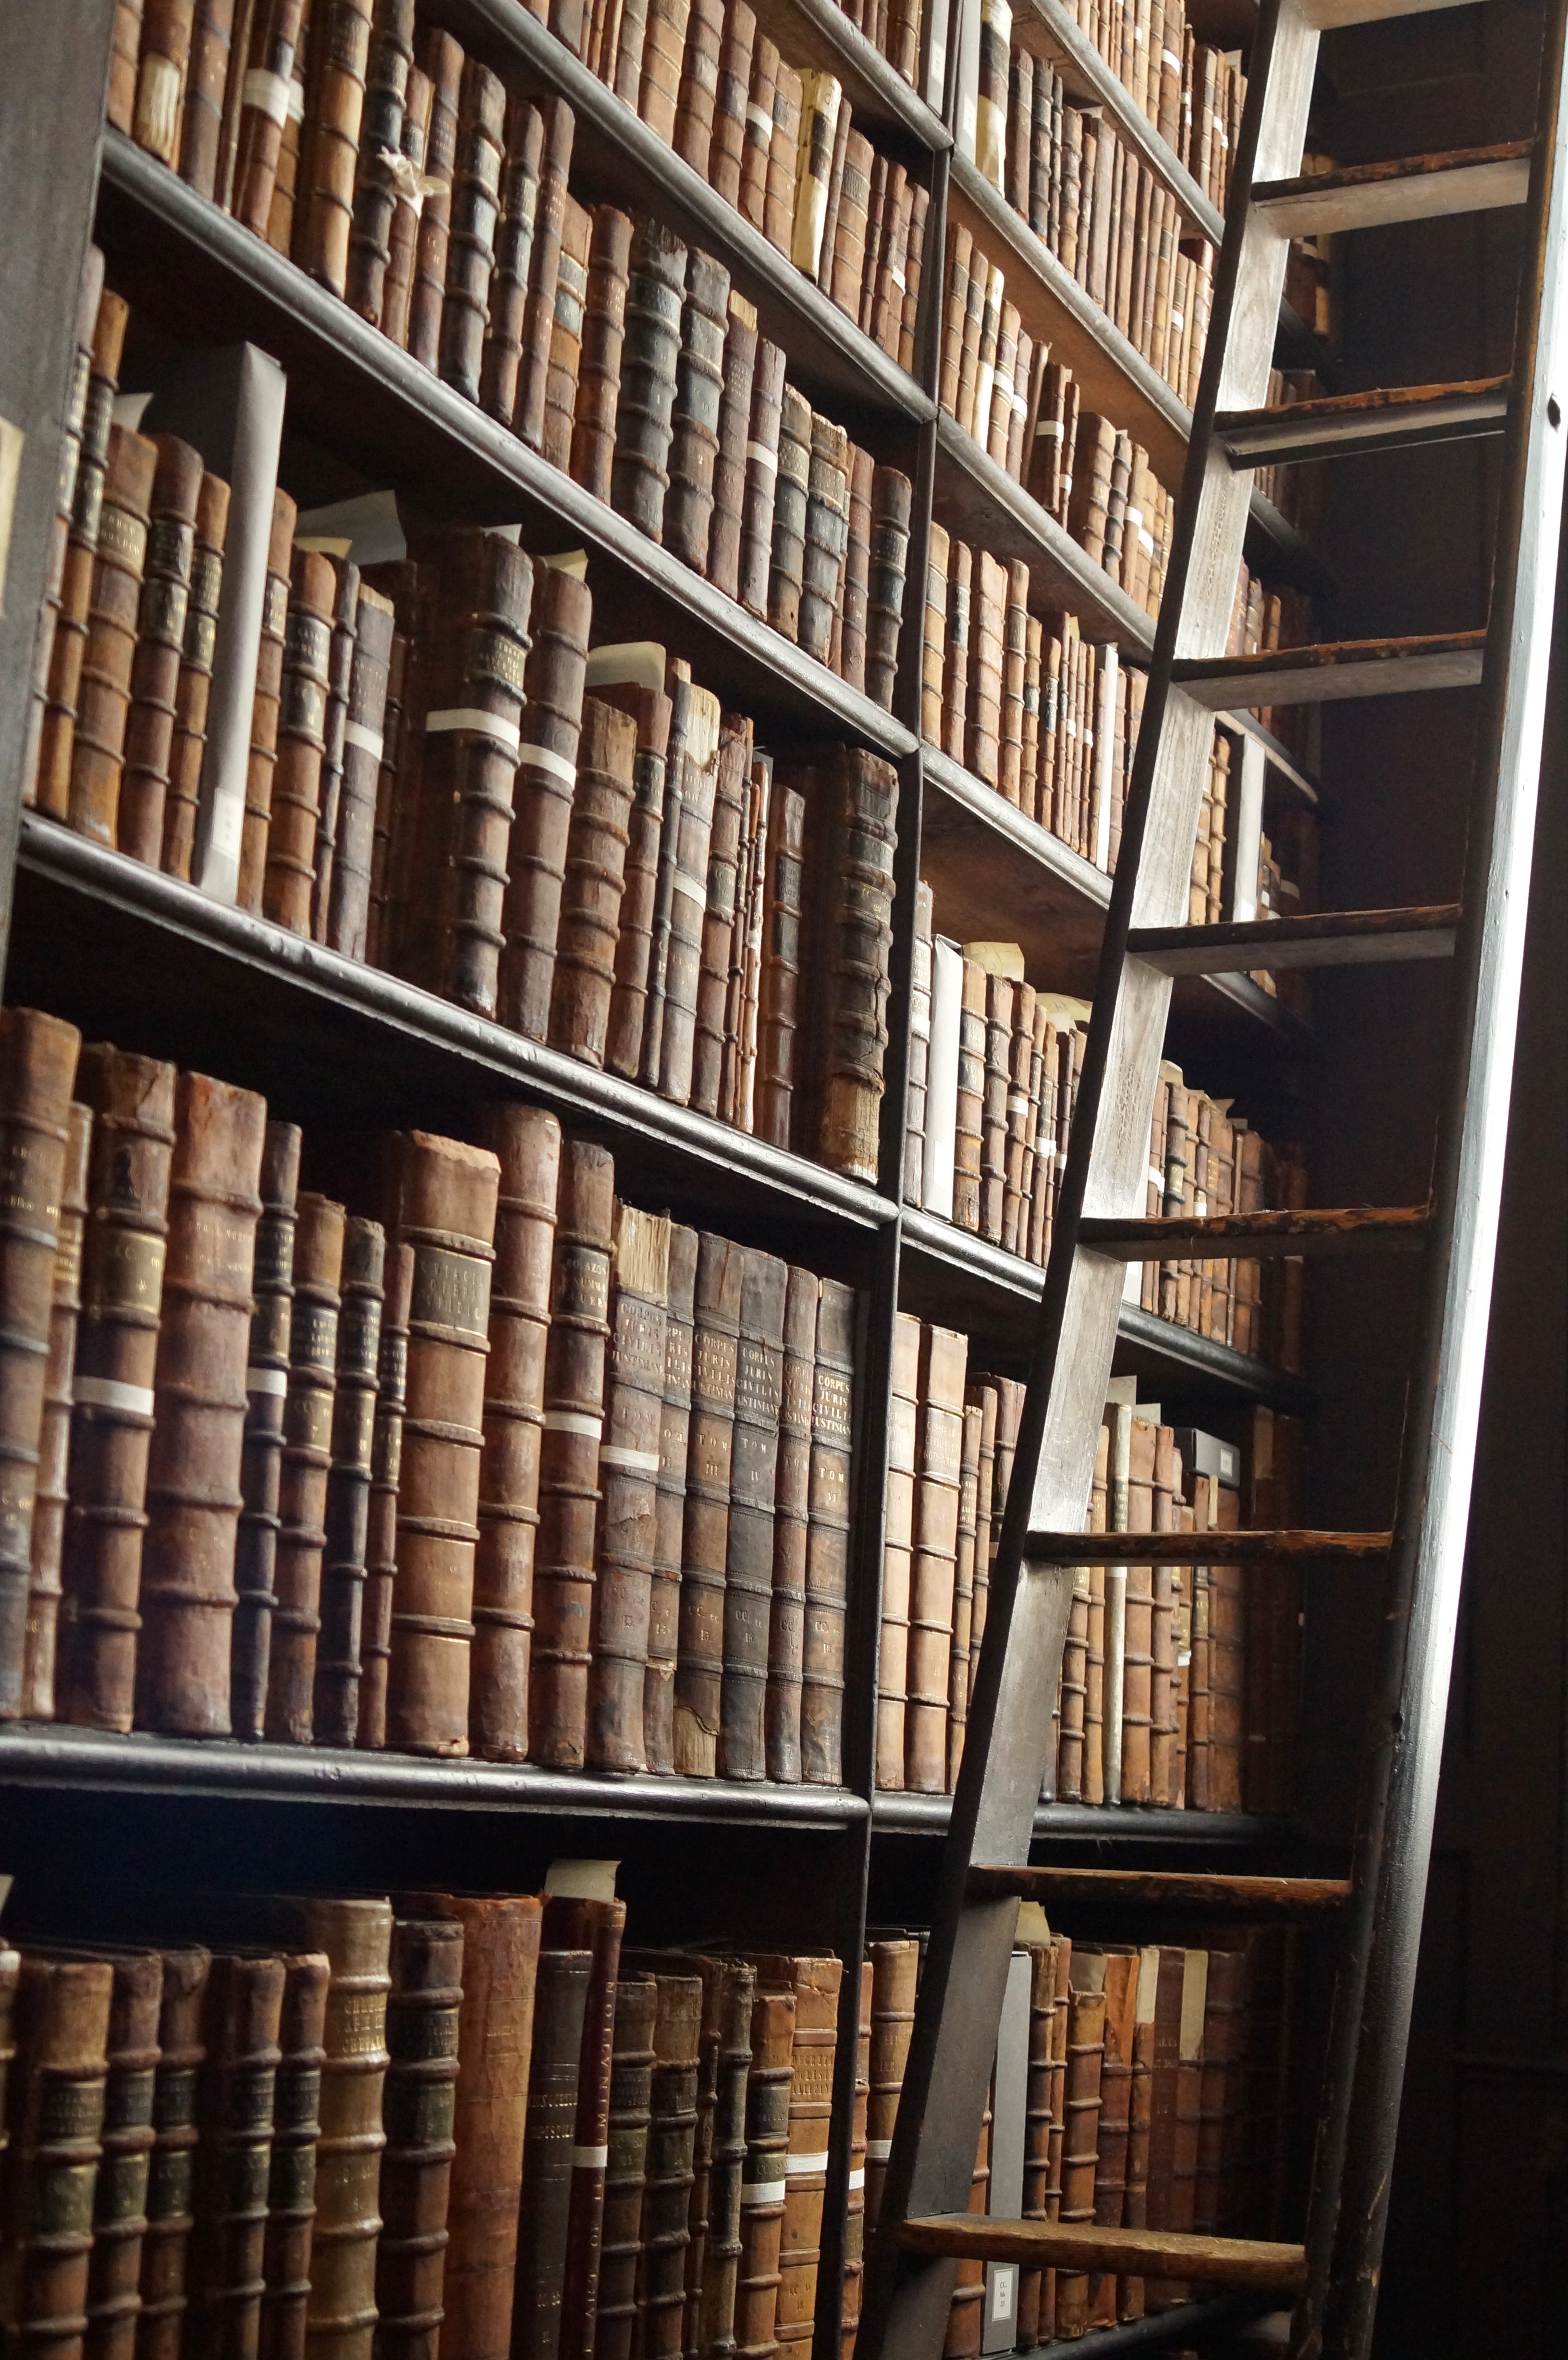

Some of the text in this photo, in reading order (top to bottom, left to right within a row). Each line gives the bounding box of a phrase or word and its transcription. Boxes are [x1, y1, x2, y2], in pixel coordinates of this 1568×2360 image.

[698, 454, 704, 465] 2
[621, 1302, 662, 1326] CORPUS
[669, 1342, 688, 1358] RIS
[695, 1333, 735, 1355] CORPUS
[667, 1356, 691, 1376] ILIS
[699, 1349, 731, 1369] JURIS
[742, 1347, 775, 1367] CORPUS
[745, 1364, 772, 1382] JURIS
[736, 1378, 779, 1399] CIVILIS
[818, 1375, 850, 1394] CORPUS
[821, 1390, 848, 1407] JURIS
[828, 1491, 837, 1503] VI
